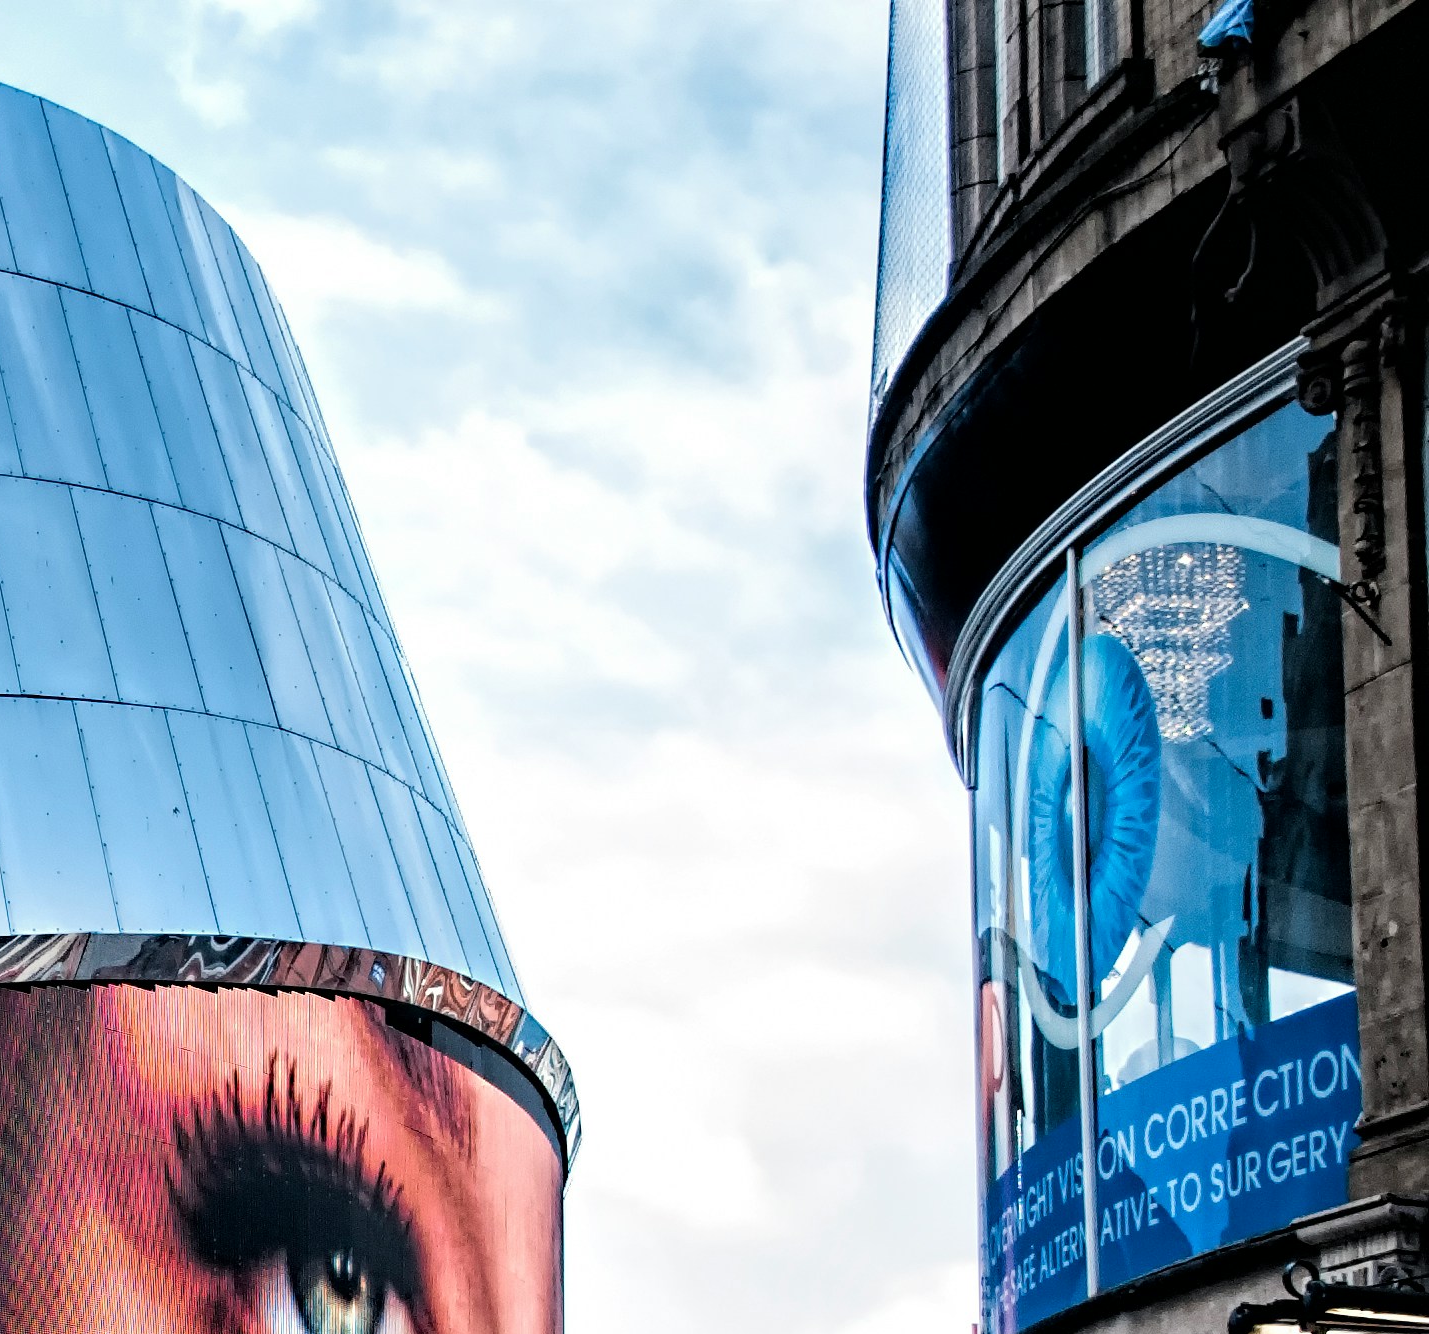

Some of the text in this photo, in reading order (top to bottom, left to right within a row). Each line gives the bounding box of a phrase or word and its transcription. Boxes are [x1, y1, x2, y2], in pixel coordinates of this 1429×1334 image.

[1057, 1124, 1136, 1198] VISON
[1144, 1043, 1362, 1159] CORRECTION
[1039, 1186, 1160, 1283] ALTERNATIVE
[1167, 1172, 1202, 1218] TO
[1210, 1121, 1349, 1204] SURGERY
